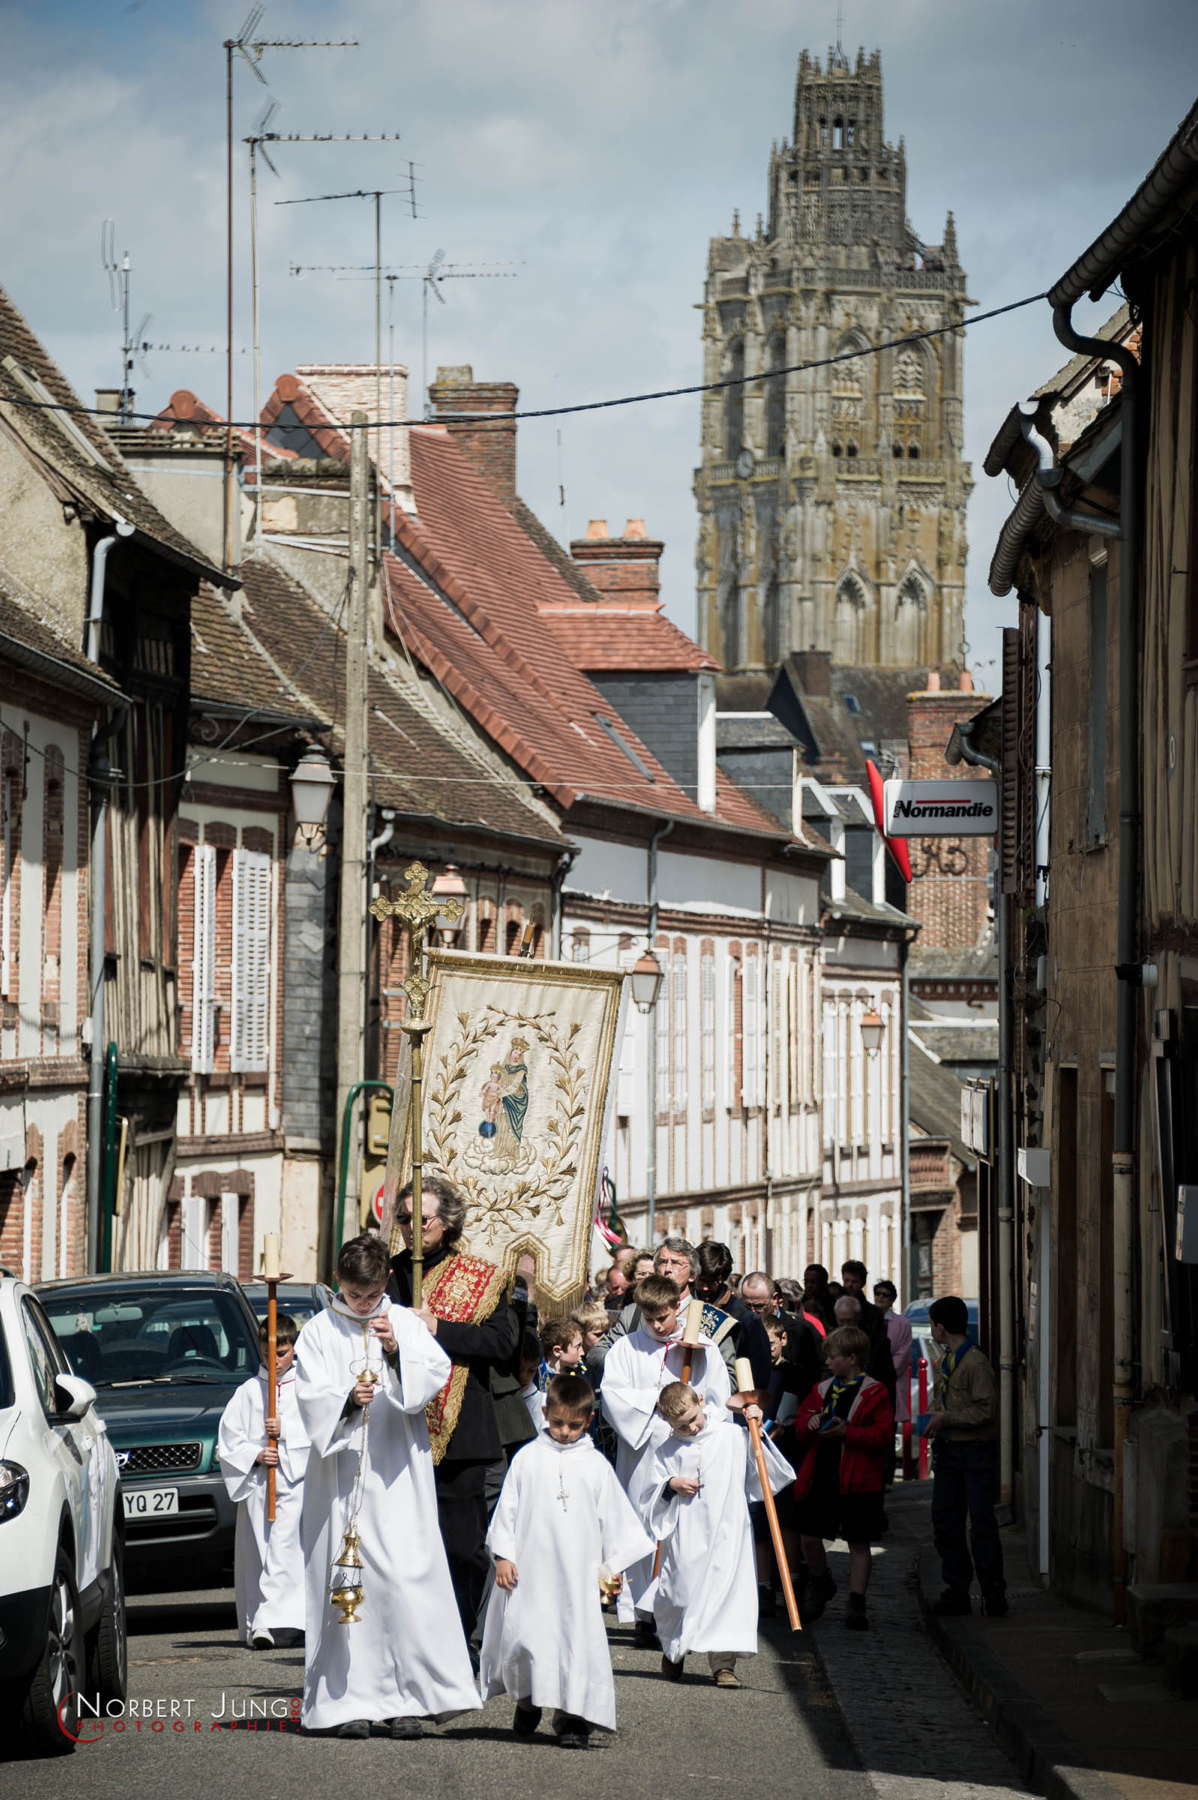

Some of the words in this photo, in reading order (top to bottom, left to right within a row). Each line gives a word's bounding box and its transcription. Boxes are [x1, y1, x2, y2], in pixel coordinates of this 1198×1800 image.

[893, 800, 993, 818] Normandie
[125, 1495, 147, 1513] YQ
[153, 1492, 175, 1511] 27
